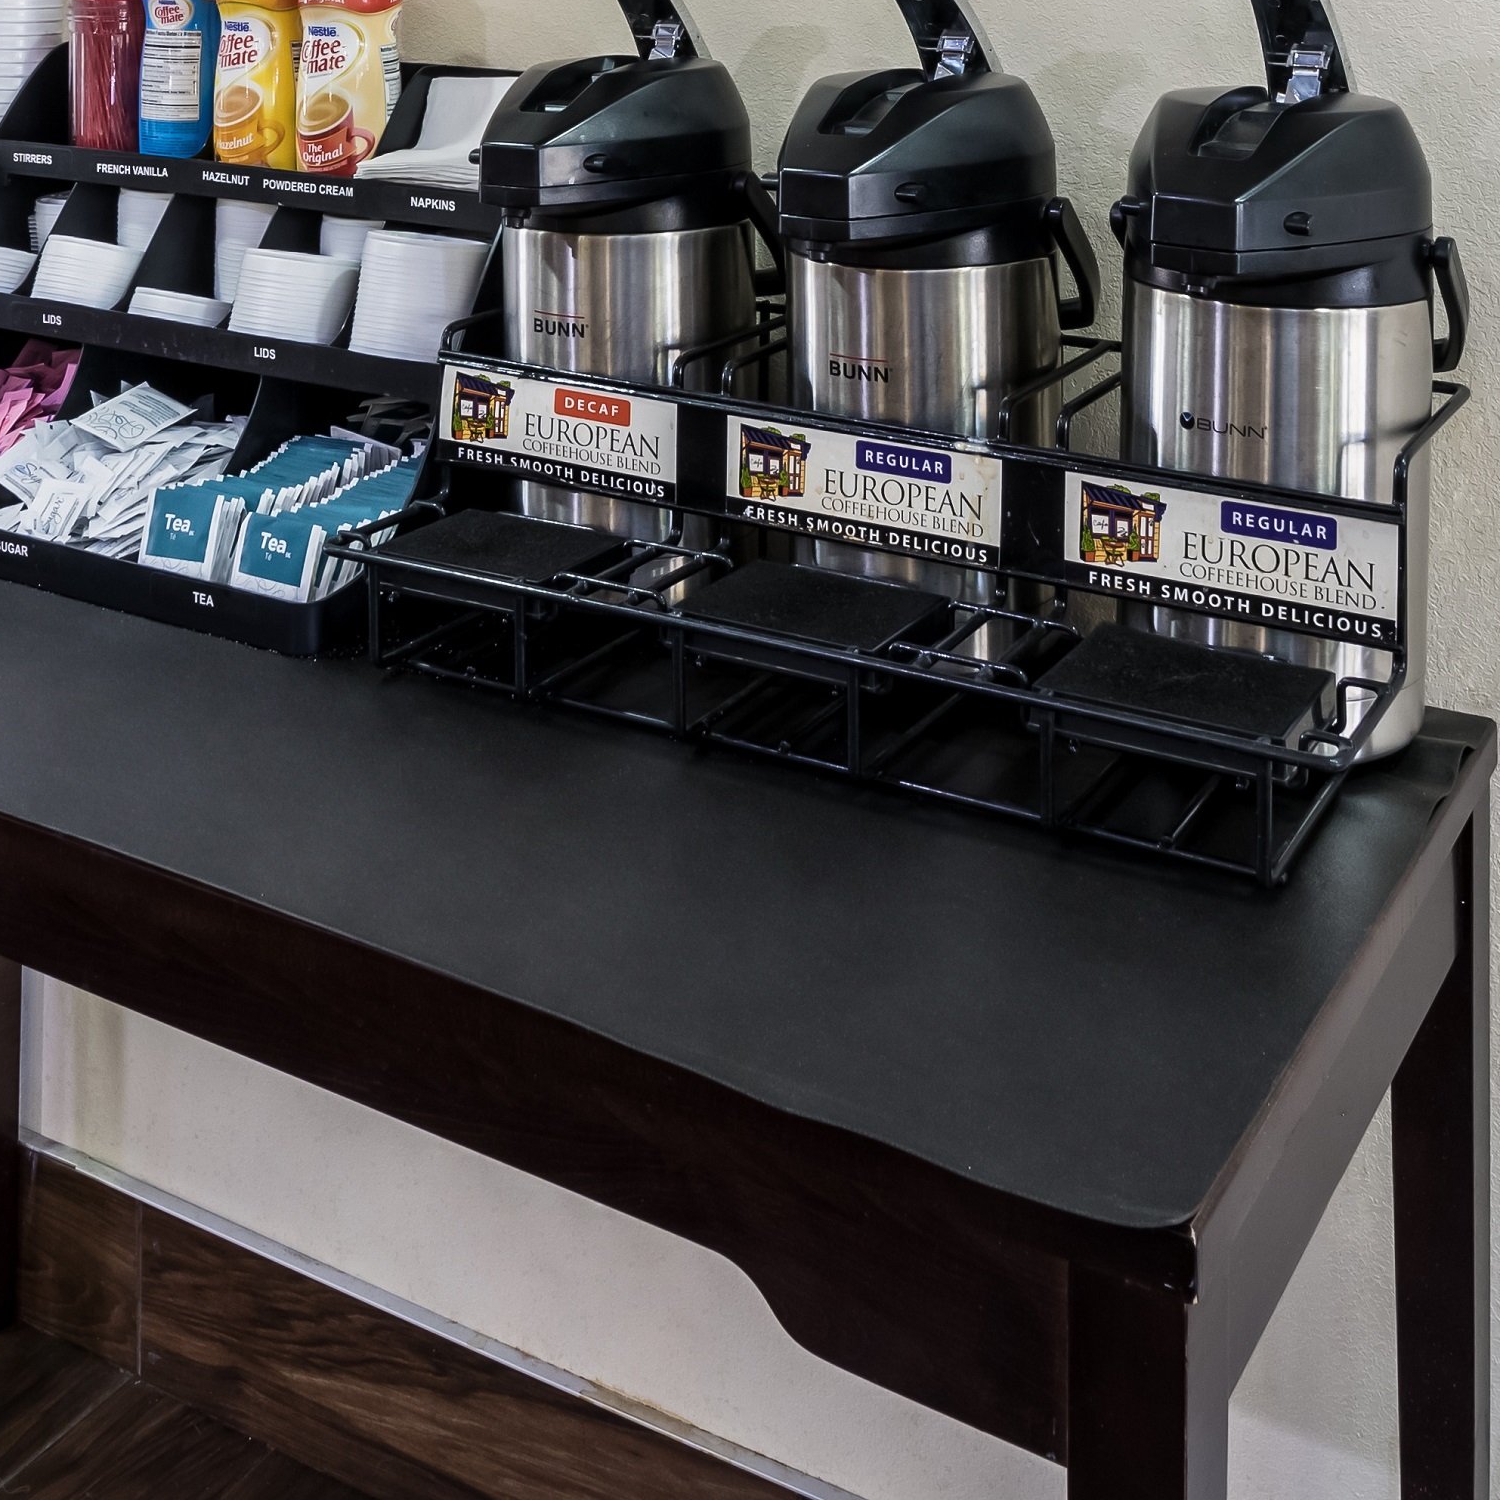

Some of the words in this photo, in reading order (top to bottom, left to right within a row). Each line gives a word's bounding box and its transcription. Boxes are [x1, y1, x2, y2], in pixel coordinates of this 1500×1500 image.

[161, 14, 184, 24] mate
[220, 49, 258, 68] mate
[307, 55, 346, 74] mate
[13, 152, 53, 165] STIRRERS
[302, 143, 344, 165] Original
[307, 143, 323, 153] The
[96, 163, 131, 175] FRENCH
[132, 165, 169, 178] VANILLA
[202, 170, 250, 186] HAZELNUT
[262, 178, 317, 194] POWDERED
[318, 184, 354, 197] CREAM
[410, 196, 456, 212] NAPKINS
[42, 313, 62, 326] LIDS
[534, 318, 585, 338] BUNN
[254, 346, 276, 360] LIDS
[829, 360, 889, 383] BUNN
[564, 396, 620, 417] DECAF
[525, 412, 661, 460] EUROPEAN
[1196, 417, 1265, 439] BUNN
[522, 438, 613, 467] COFFEEHOUSE
[616, 457, 661, 476] BLEND
[865, 450, 944, 475] REGULAR
[458, 447, 503, 465] FRESH
[510, 456, 574, 480] SMOOTH
[581, 470, 665, 498] DELICIOUS
[824, 468, 983, 521] EUROPEAN
[165, 513, 191, 532] Tea
[821, 496, 928, 528] COFFEEHOUSE
[932, 517, 984, 538] BLEND
[1232, 511, 1328, 540] REGULAR
[261, 531, 287, 554] Tea
[747, 505, 799, 526] FRESH
[806, 517, 880, 542] SMOOTH
[889, 532, 987, 563] DELICIOUS
[1182, 531, 1376, 592] EUROPEAN
[1179, 561, 1309, 599] COFFEEHOUSE
[1313, 585, 1377, 610] BLEND
[192, 591, 215, 607] TEA
[1089, 570, 1151, 595] FRESH
[1161, 584, 1250, 614] SMOOTH
[1261, 603, 1382, 638] DELICIOUS
